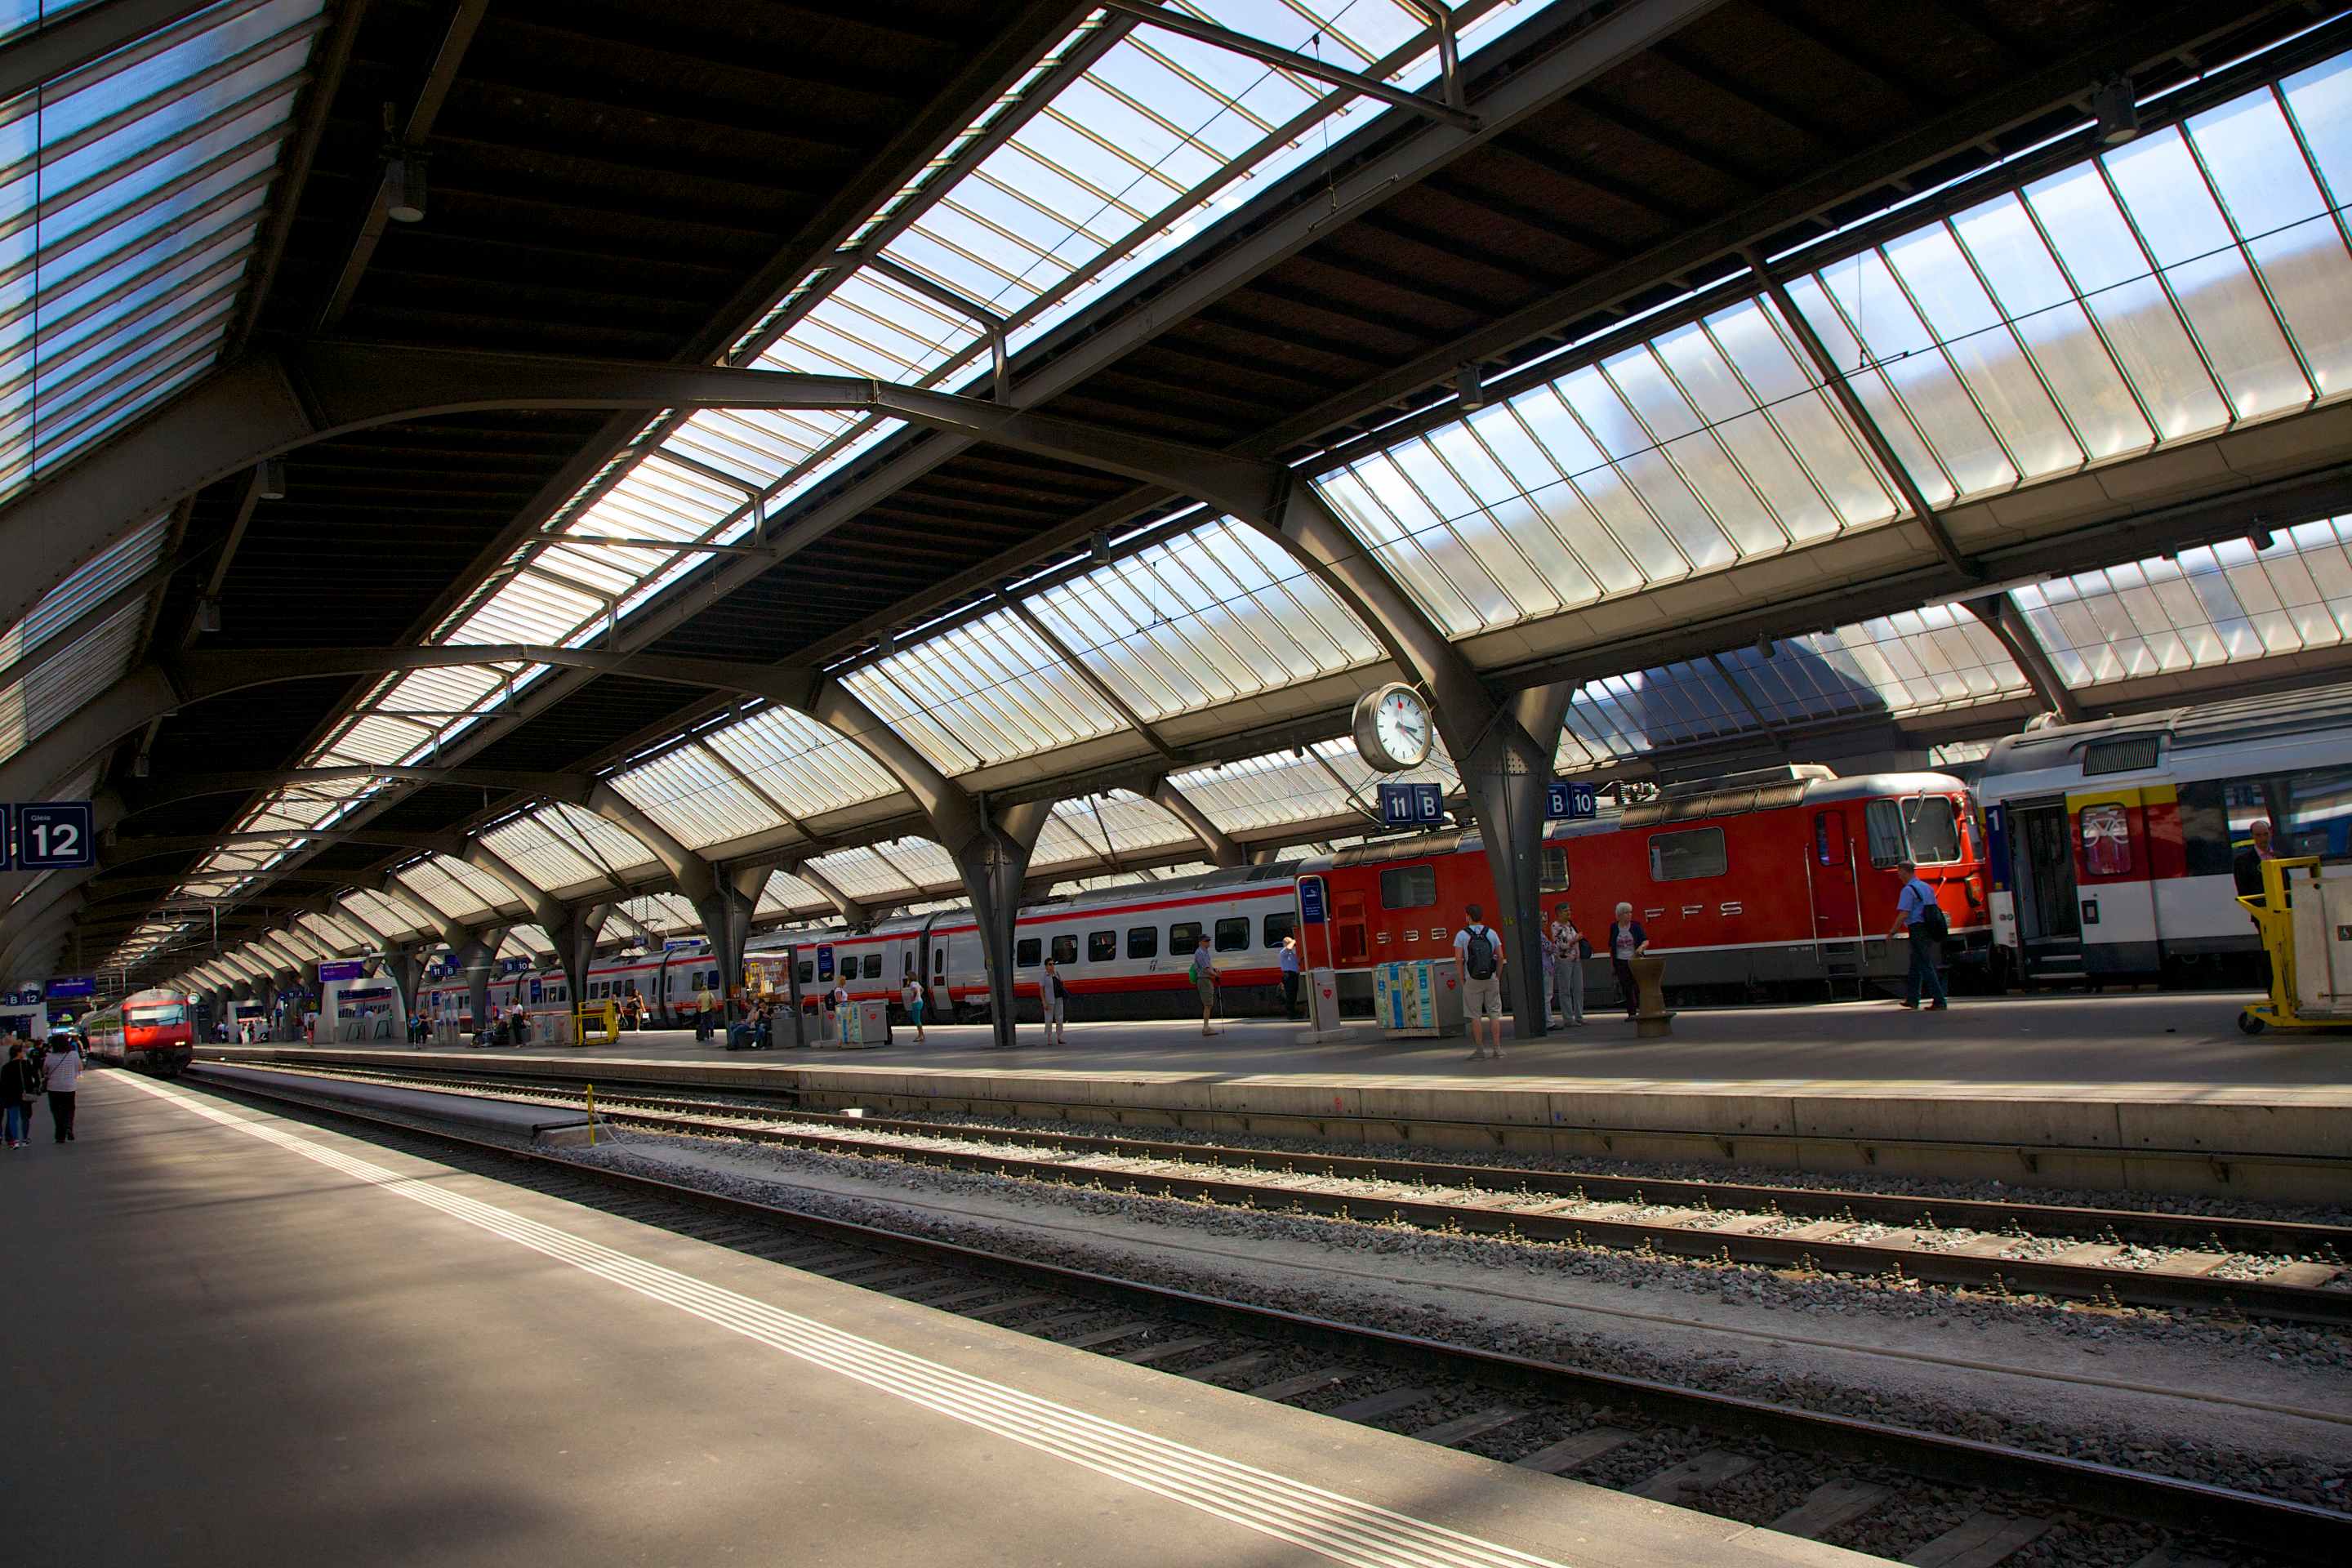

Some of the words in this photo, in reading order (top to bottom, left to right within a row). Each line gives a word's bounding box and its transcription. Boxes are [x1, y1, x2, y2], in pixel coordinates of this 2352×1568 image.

[1391, 796, 1406, 817] 11
[1423, 796, 1436, 817] B
[1552, 794, 1564, 813] B
[1575, 794, 1592, 813] 10
[1988, 809, 2000, 831] 1
[32, 823, 79, 857] 12
[519, 962, 528, 970] 10
[9, 996, 18, 1004] B
[26, 994, 38, 1003] 12
